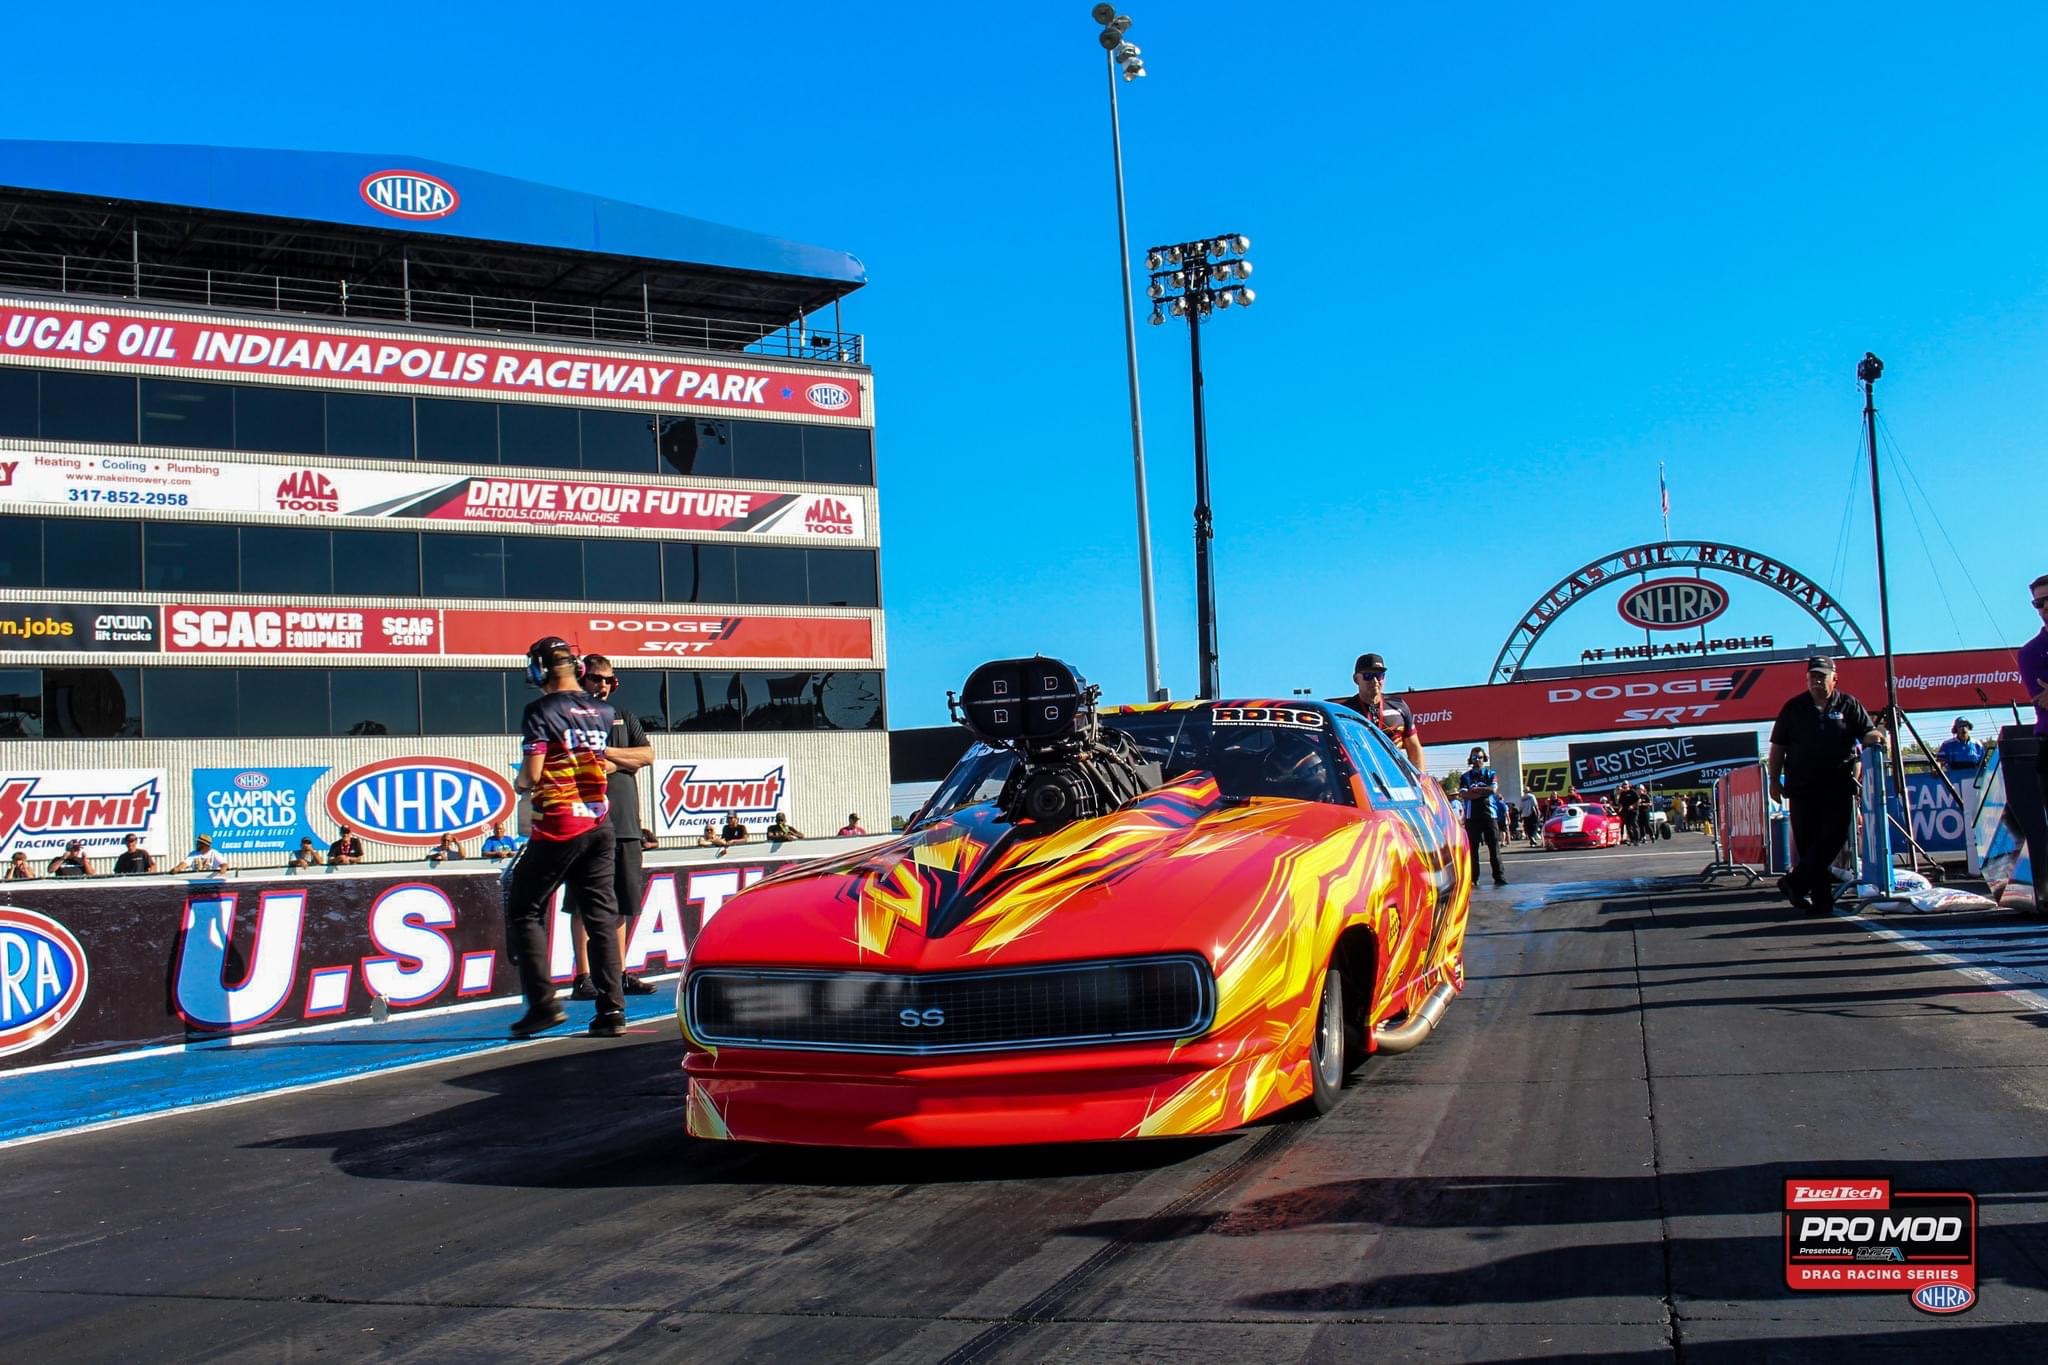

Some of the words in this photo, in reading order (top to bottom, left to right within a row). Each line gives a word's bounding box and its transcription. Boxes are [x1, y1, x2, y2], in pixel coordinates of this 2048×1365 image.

[375, 179, 446, 211] NHRA
[0, 313, 110, 352] UCAS
[117, 323, 177, 359] OIL
[192, 330, 488, 381] INDIANAPOLIS
[493, 354, 674, 394] RACEWAY
[676, 371, 770, 403] PARK
[813, 388, 845, 405] NHRA
[34, 456, 81, 469] Heating
[102, 459, 147, 473] Cooling
[167, 463, 220, 477] Plumbing
[66, 472, 191, 486] www.makeitmowery.com
[276, 470, 339, 500] MAC
[68, 488, 189, 506] 317-852-2958
[276, 500, 339, 512] TOOLS
[467, 480, 557, 511] DRIVE
[563, 485, 638, 514] YOUR
[643, 490, 752, 519] FUTURE
[464, 506, 620, 524] MACTOOLS.COM/FRANCHISE
[804, 498, 853, 524] MAC
[805, 524, 853, 535] TOOLS
[1622, 545, 1672, 569] OIL
[1699, 544, 1832, 613] RACEWAY
[1635, 587, 1715, 622] NHRA
[172, 610, 281, 647] SCAG
[285, 612, 364, 630] POWER
[382, 617, 434, 636] SCAG
[589, 619, 726, 634] DODGE
[95, 631, 111, 641] lift
[112, 631, 152, 641] trucks
[286, 631, 363, 648] EQUIPMENT
[389, 635, 428, 646] .COM
[638, 641, 714, 655] SRT
[1582, 648, 1606, 661] AT
[1615, 635, 1774, 659] INDIANAPOLIS
[1548, 677, 1735, 703] DODGE
[1615, 703, 1720, 723] SRT
[239, 775, 266, 787] NHRA
[207, 790, 296, 808] CAMPING
[357, 771, 492, 831] NHRA
[208, 807, 297, 828] WORLD
[679, 818, 716, 826] RACING
[212, 829, 233, 838] DRAG
[236, 829, 265, 837] RACING
[267, 828, 295, 836] SERIES
[14, 839, 65, 849] RACING
[173, 882, 497, 1032] U.S.
[900, 1008, 945, 1027] SS
